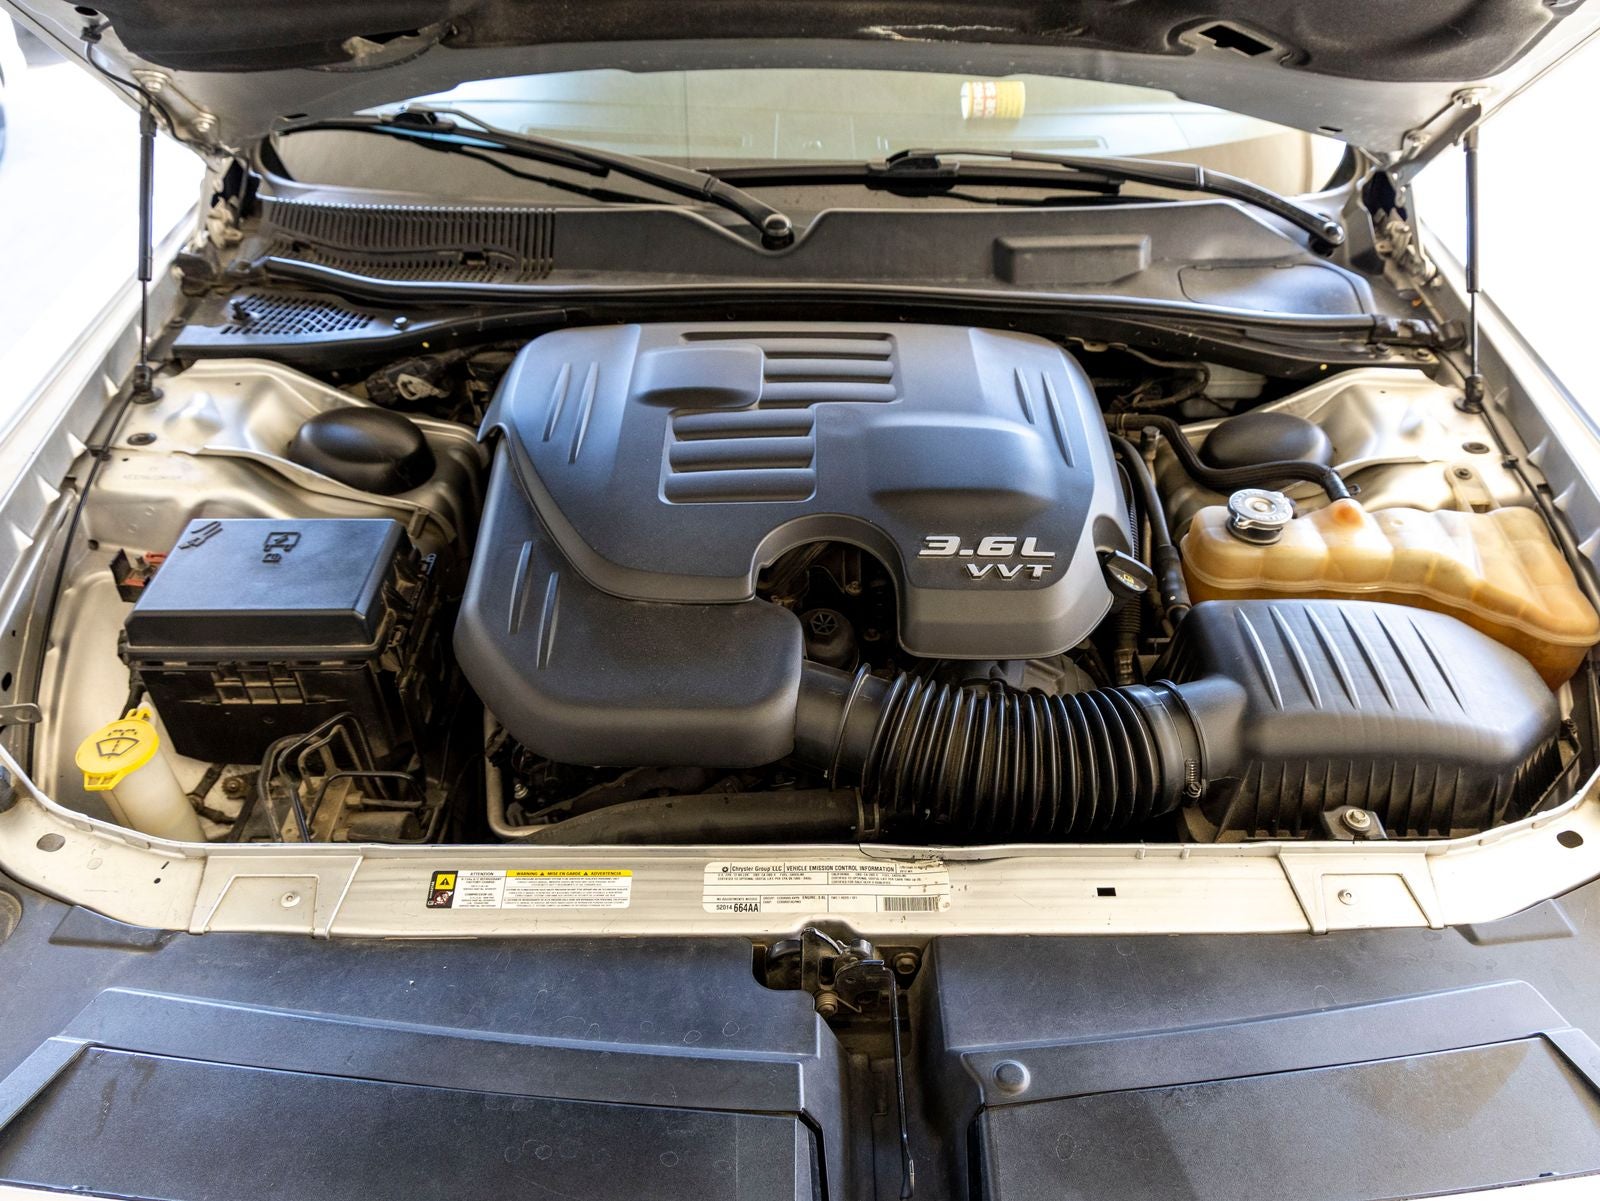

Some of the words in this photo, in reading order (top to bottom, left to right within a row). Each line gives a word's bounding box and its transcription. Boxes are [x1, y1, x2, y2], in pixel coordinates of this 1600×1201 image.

[917, 536, 1056, 559] 3.6L
[965, 563, 1052, 581] VVT
[733, 903, 759, 912] 664AA
